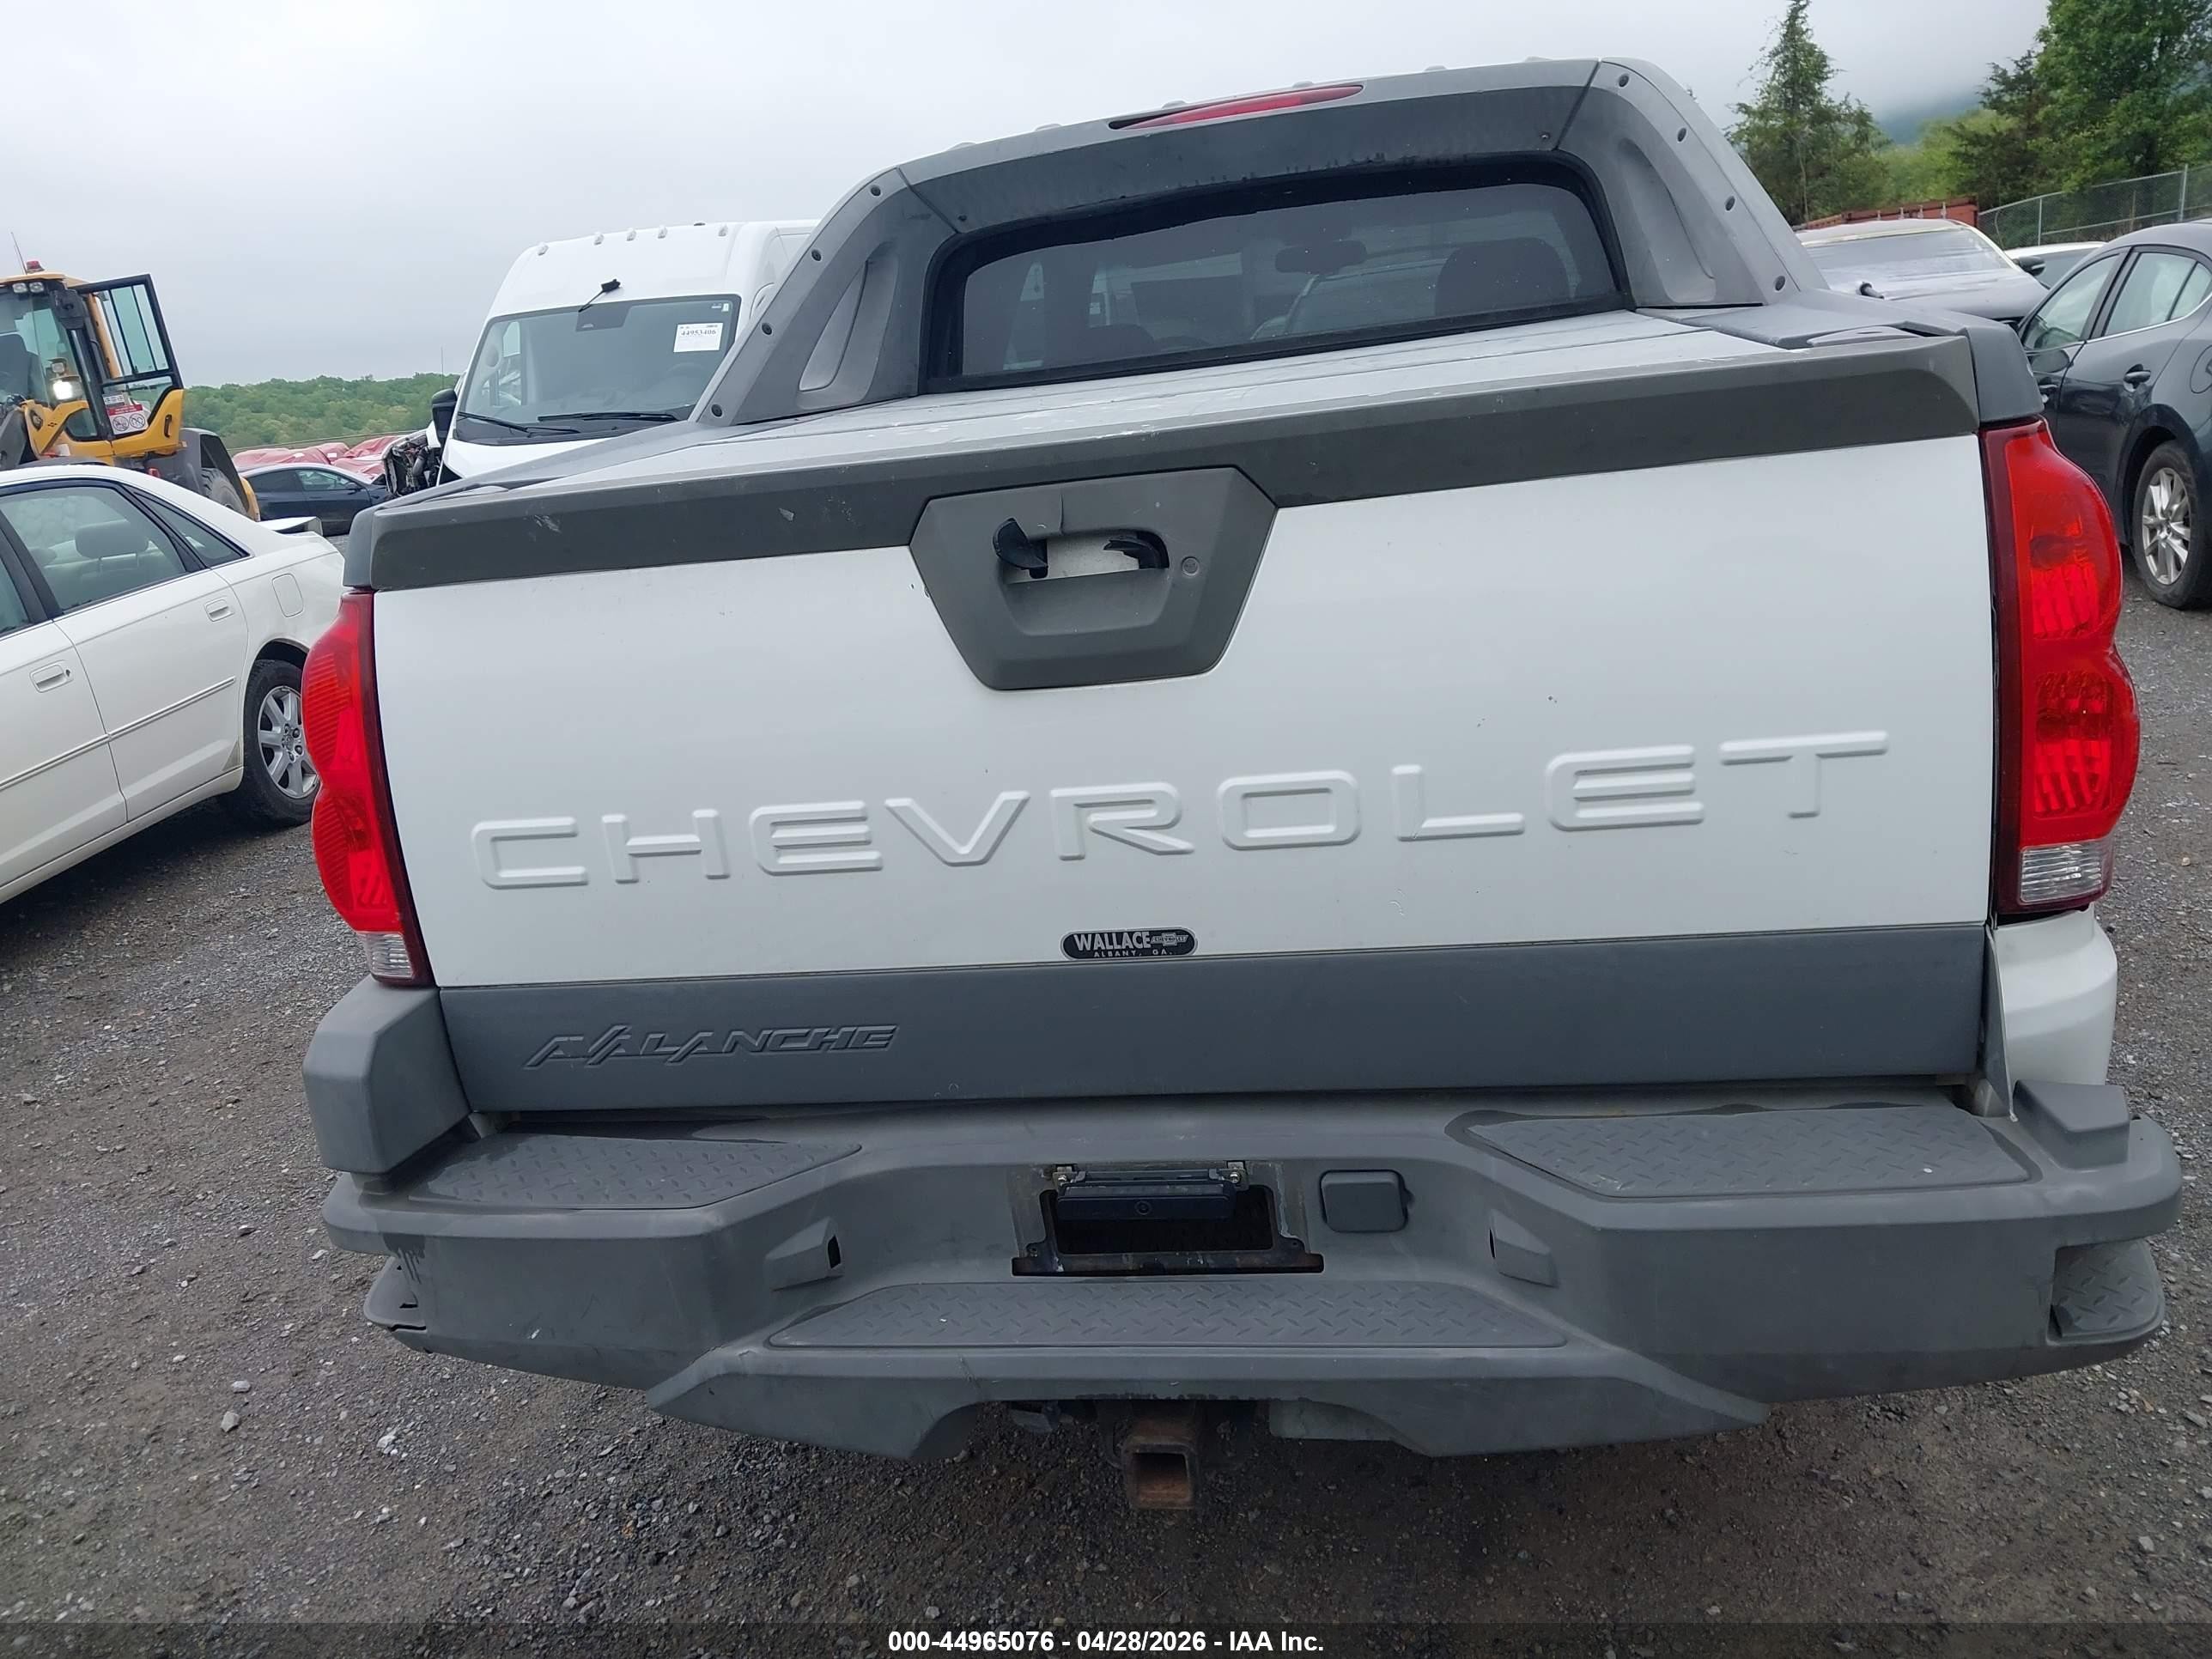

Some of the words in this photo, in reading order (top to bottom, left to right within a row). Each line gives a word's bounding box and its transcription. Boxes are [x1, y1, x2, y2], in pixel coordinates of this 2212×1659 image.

[471, 730, 1887, 890] CHEVROLET
[1074, 932, 1151, 951] WALLACE
[522, 1024, 899, 1070] AVALANCHE
